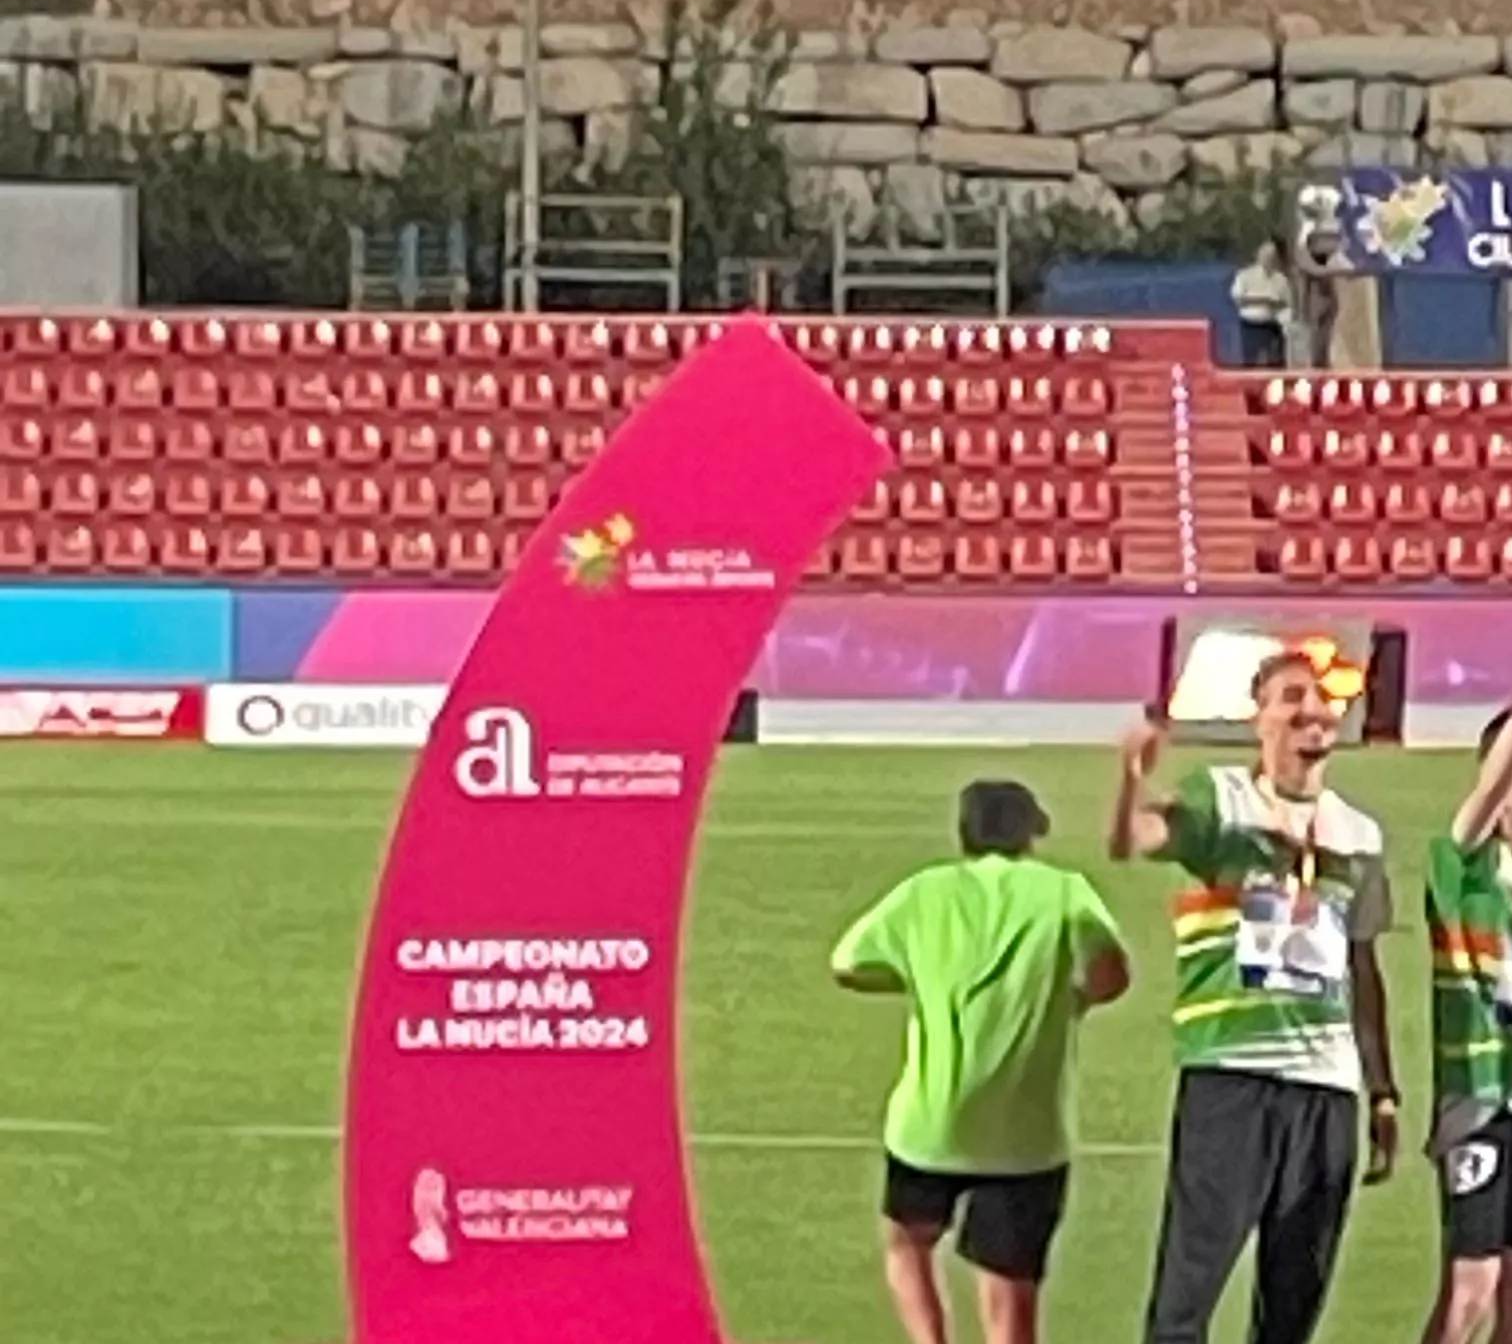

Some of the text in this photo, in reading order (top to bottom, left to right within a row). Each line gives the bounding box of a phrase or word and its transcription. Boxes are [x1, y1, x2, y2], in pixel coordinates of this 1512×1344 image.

[293, 697, 427, 730] qualit
[397, 939, 650, 971] CAMPEONATO
[452, 973, 594, 1012] ESPAÑA
[397, 1017, 442, 1049] LA
[559, 1017, 649, 1049] 2024
